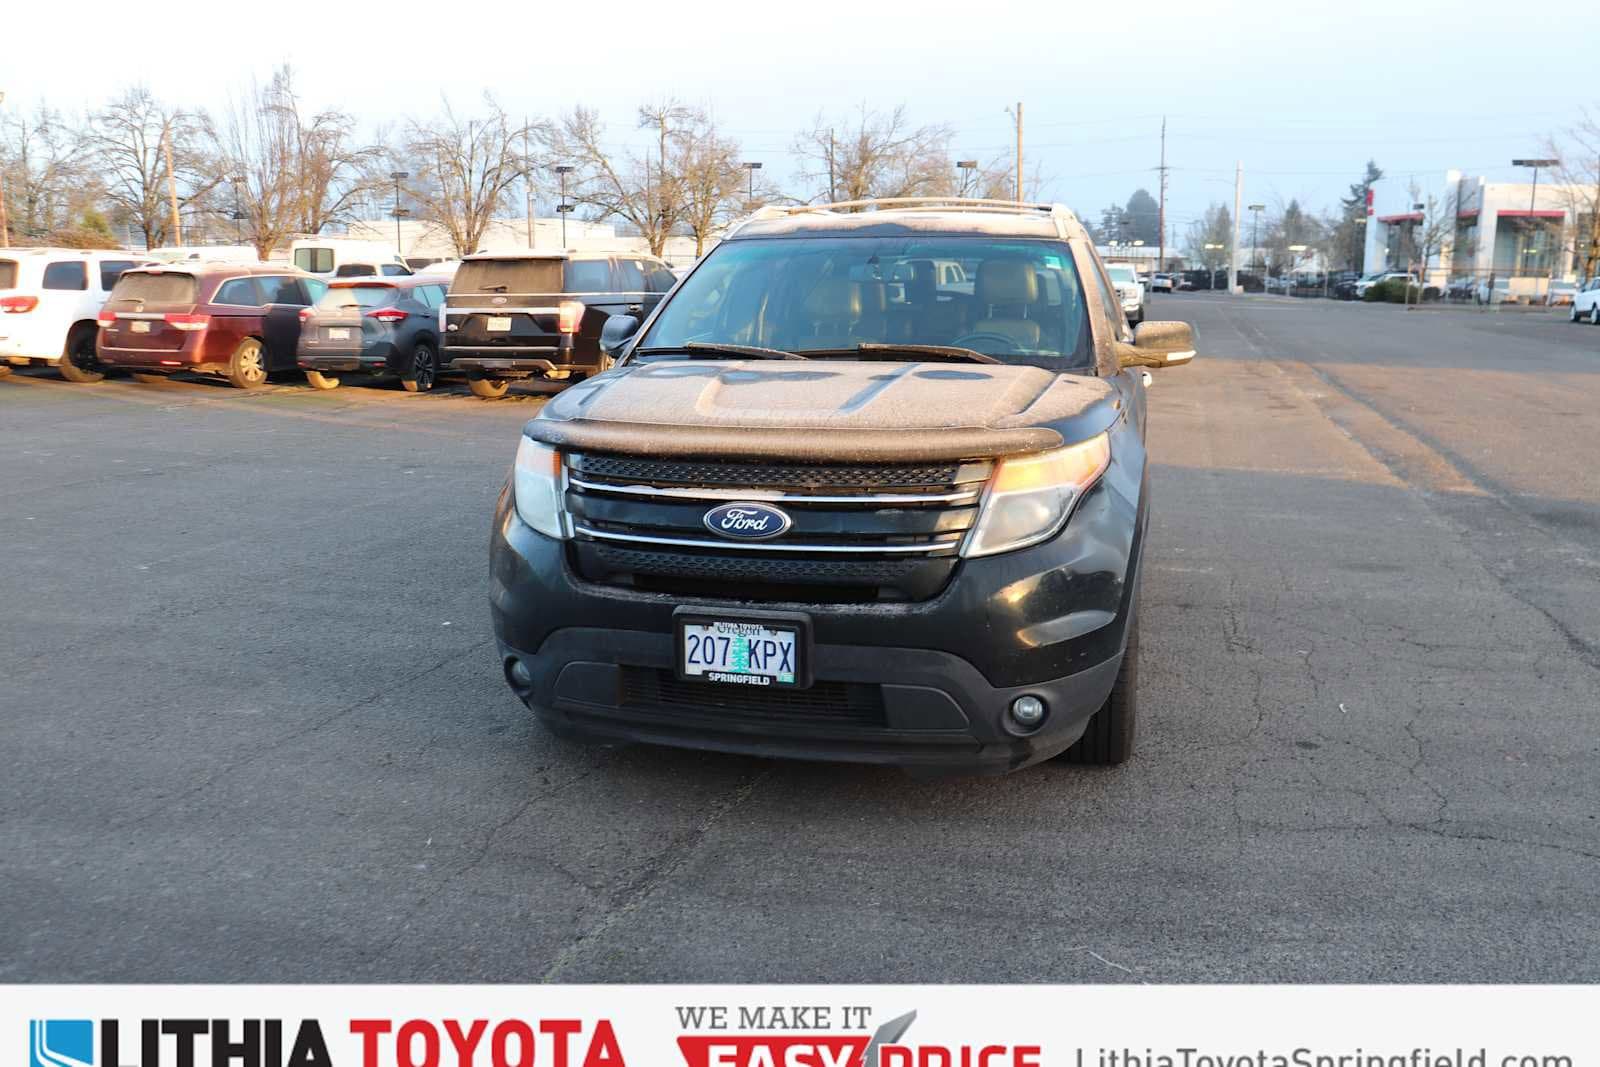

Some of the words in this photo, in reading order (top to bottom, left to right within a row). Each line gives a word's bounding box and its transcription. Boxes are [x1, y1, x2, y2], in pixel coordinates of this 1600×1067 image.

[721, 508, 770, 530] Ford
[687, 634, 731, 666] 207
[748, 638, 792, 673] KPX
[708, 672, 770, 686] SPRINGFIELD
